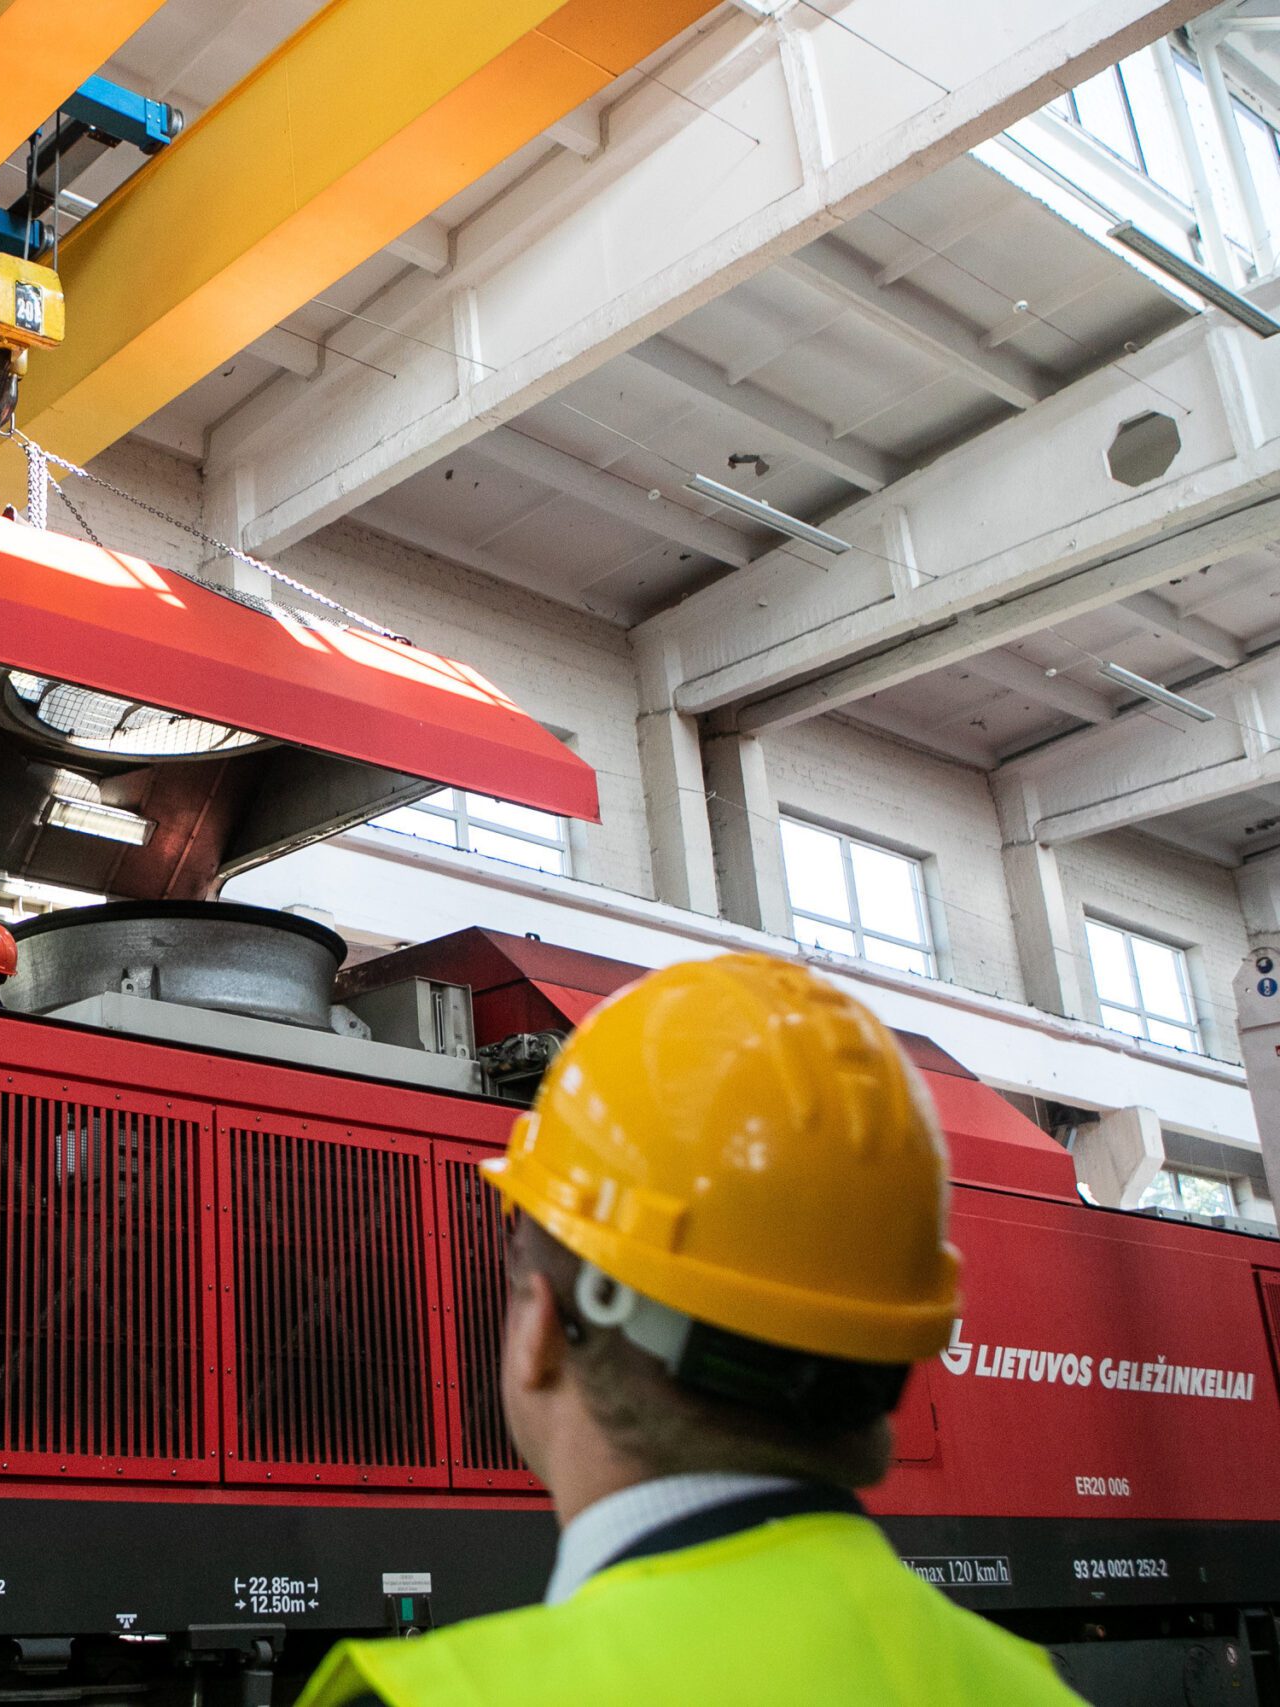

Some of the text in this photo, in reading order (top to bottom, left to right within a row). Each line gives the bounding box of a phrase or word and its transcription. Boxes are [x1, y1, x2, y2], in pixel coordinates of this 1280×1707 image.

[975, 1344, 1254, 1400] LIETUVOS GELEŽINKELIAI
[1075, 1476, 1130, 1496] ER20 006
[948, 1560, 973, 1582] 120
[974, 1560, 1009, 1581] km/h
[1073, 1559, 1169, 1579] 93 24 0021 252-2
[248, 1577, 305, 1594] 22.85m
[250, 1595, 306, 1613] 12.50m
